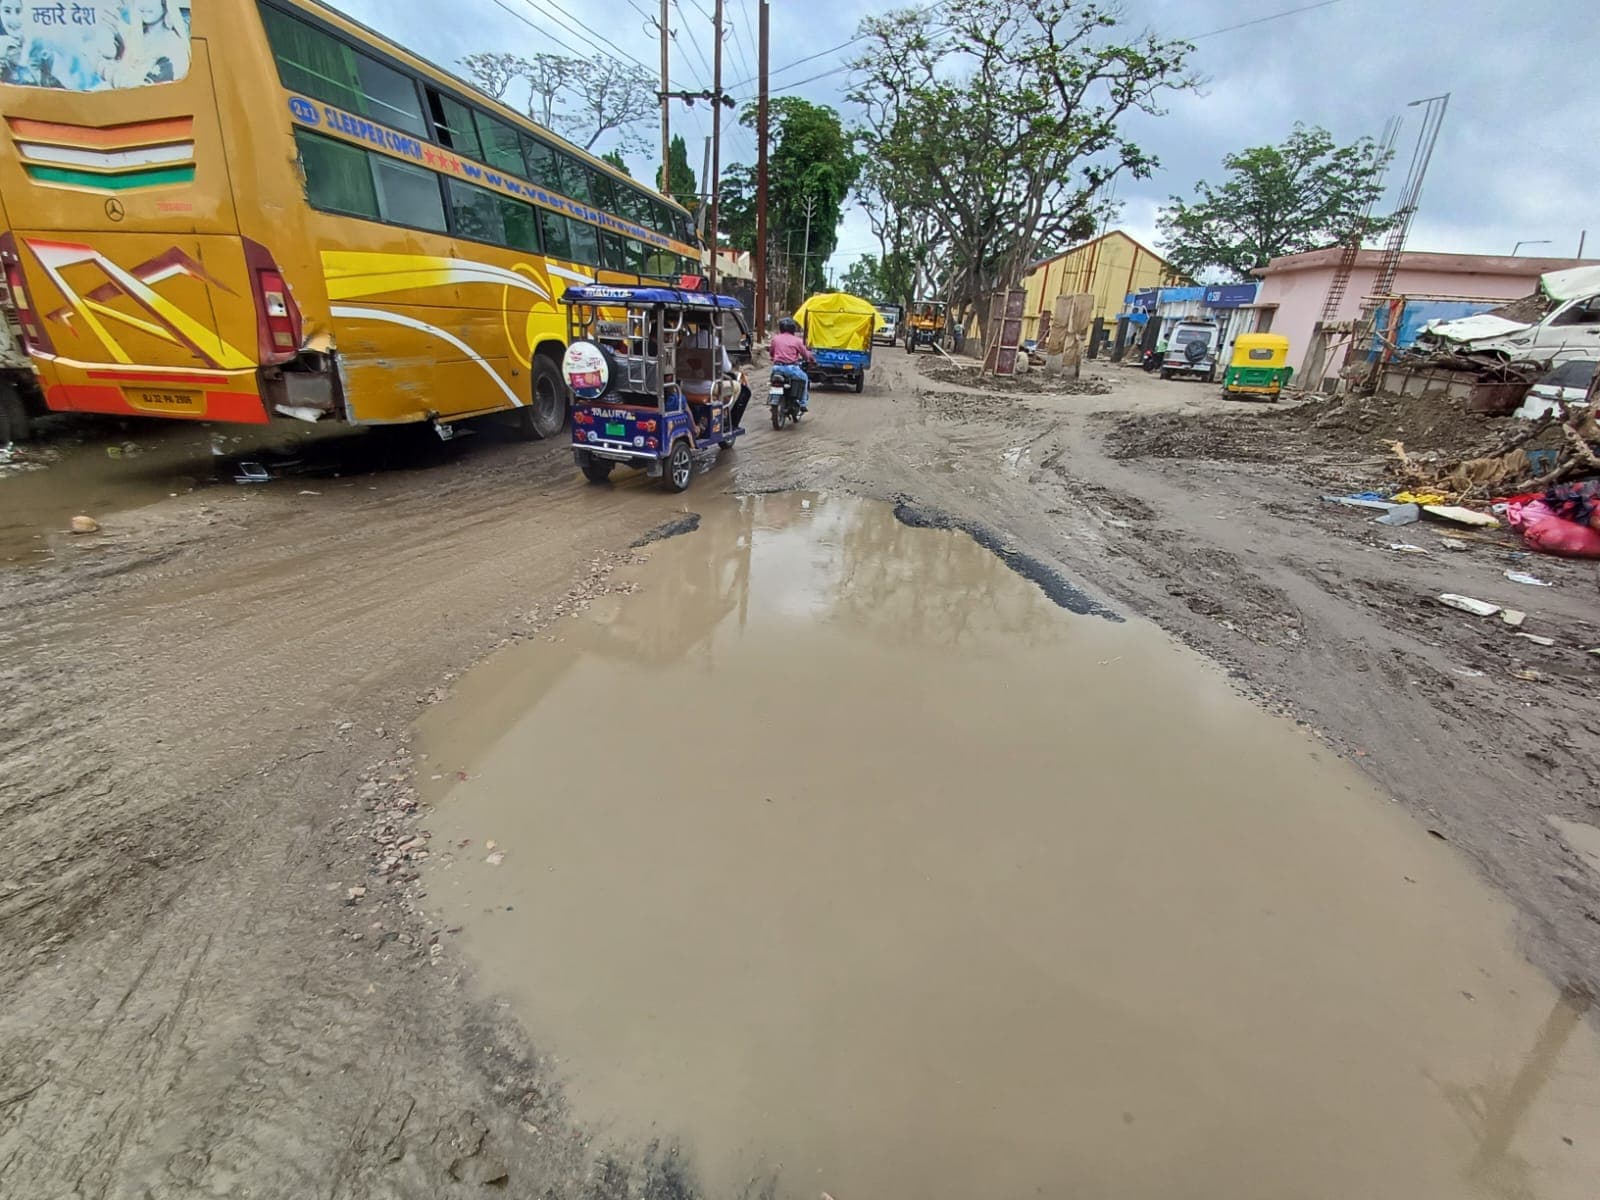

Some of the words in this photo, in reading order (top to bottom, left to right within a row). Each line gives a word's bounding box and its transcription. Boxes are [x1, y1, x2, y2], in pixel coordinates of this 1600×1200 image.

[32, 3, 67, 25] म्हारे
[71, 2, 96, 25] देश
[324, 107, 386, 147] SLEEPER
